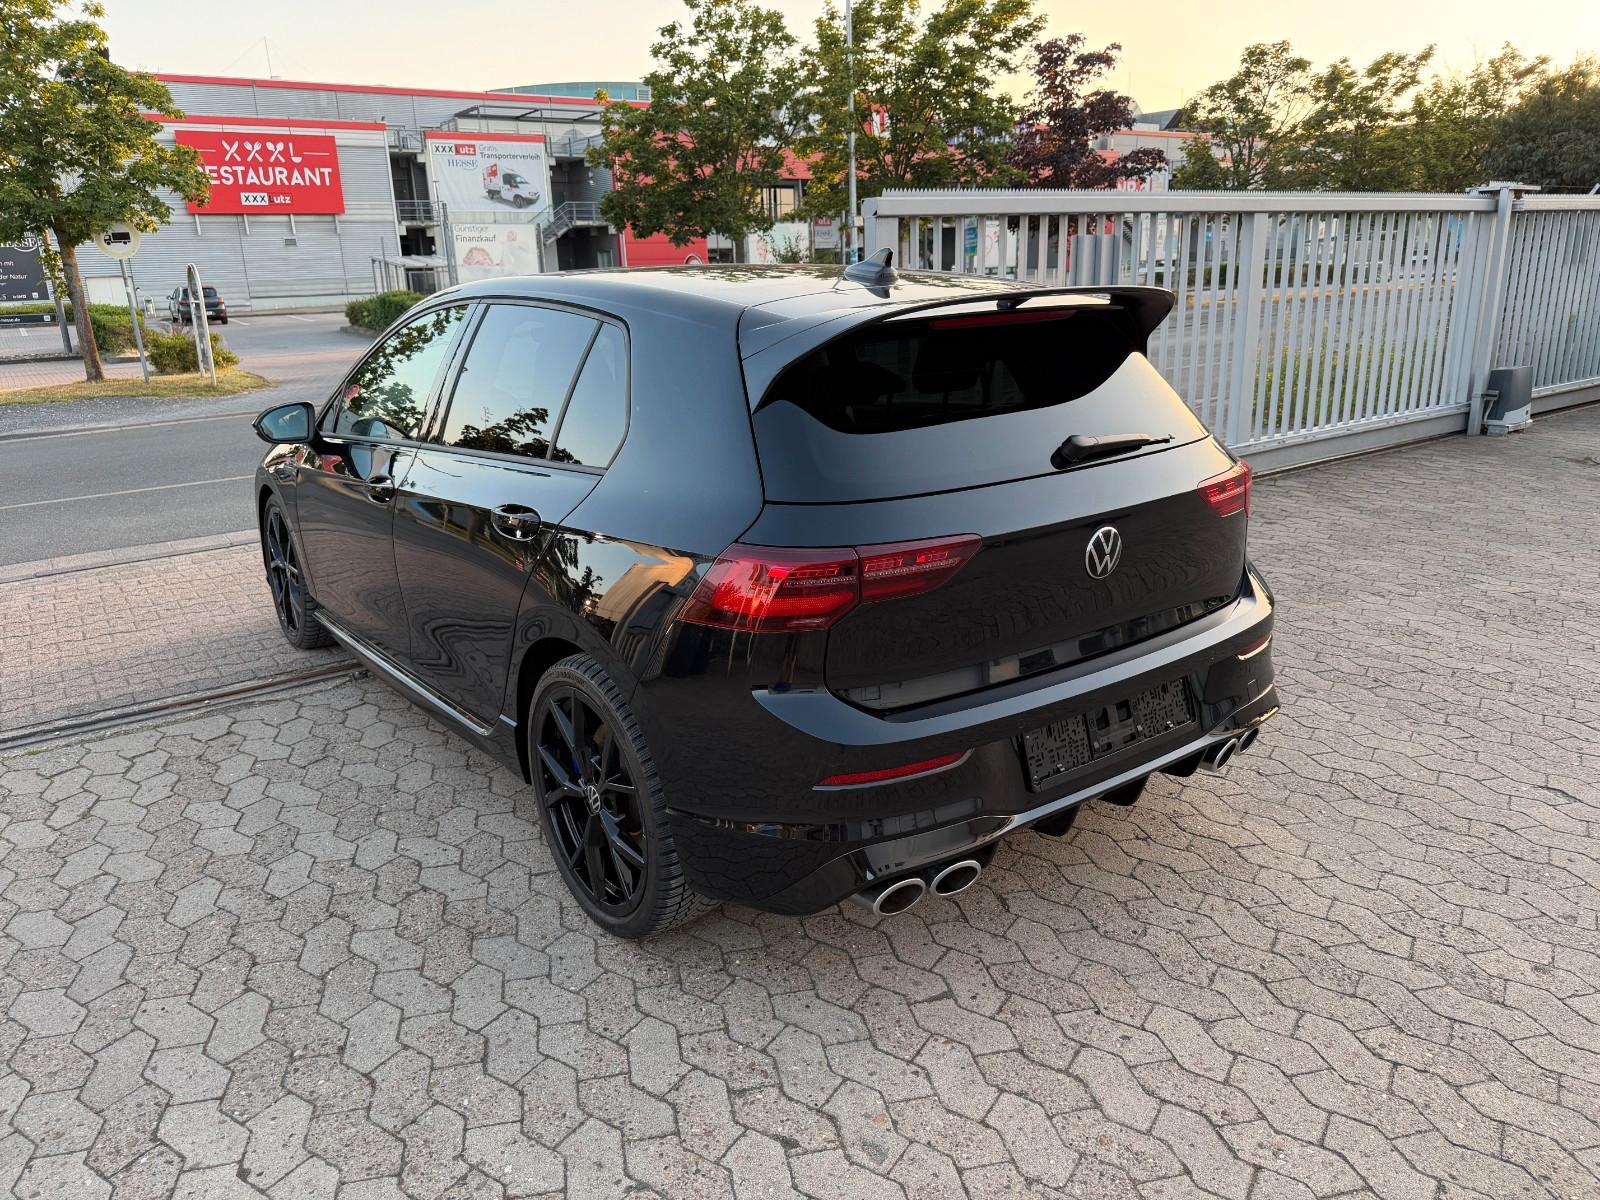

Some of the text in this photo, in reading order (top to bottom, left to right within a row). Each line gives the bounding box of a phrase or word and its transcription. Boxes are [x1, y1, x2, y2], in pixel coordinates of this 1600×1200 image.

[480, 151, 541, 161] Transporterverleih
[197, 165, 333, 187] ESTAURANT
[456, 234, 496, 243] Finanzkauf
